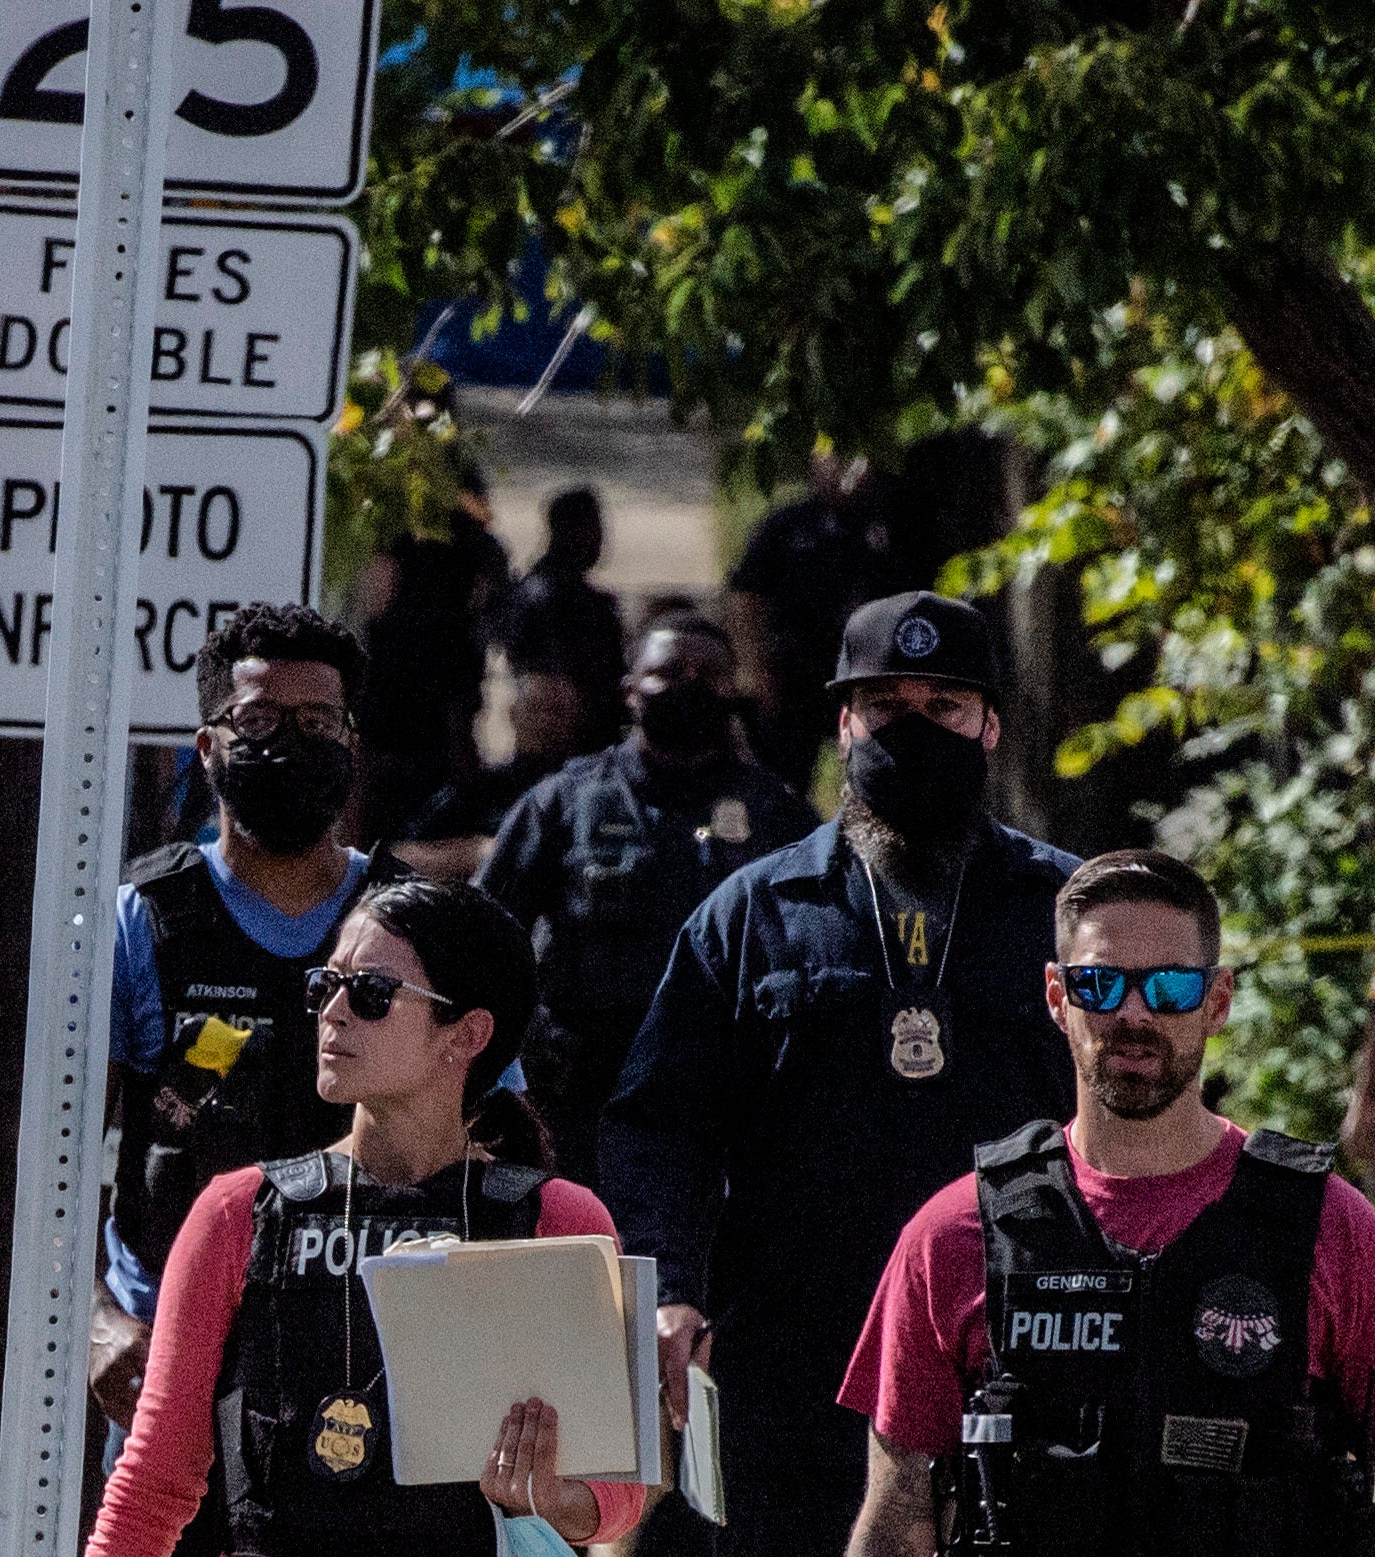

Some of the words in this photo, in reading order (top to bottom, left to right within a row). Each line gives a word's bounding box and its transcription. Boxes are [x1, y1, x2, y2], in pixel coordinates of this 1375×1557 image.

[41, 237, 251, 304] FES
[186, 984, 257, 999] ATKINSON
[1036, 1274, 1107, 1290] GENUNG
[1009, 1311, 1123, 1351] POLICE
